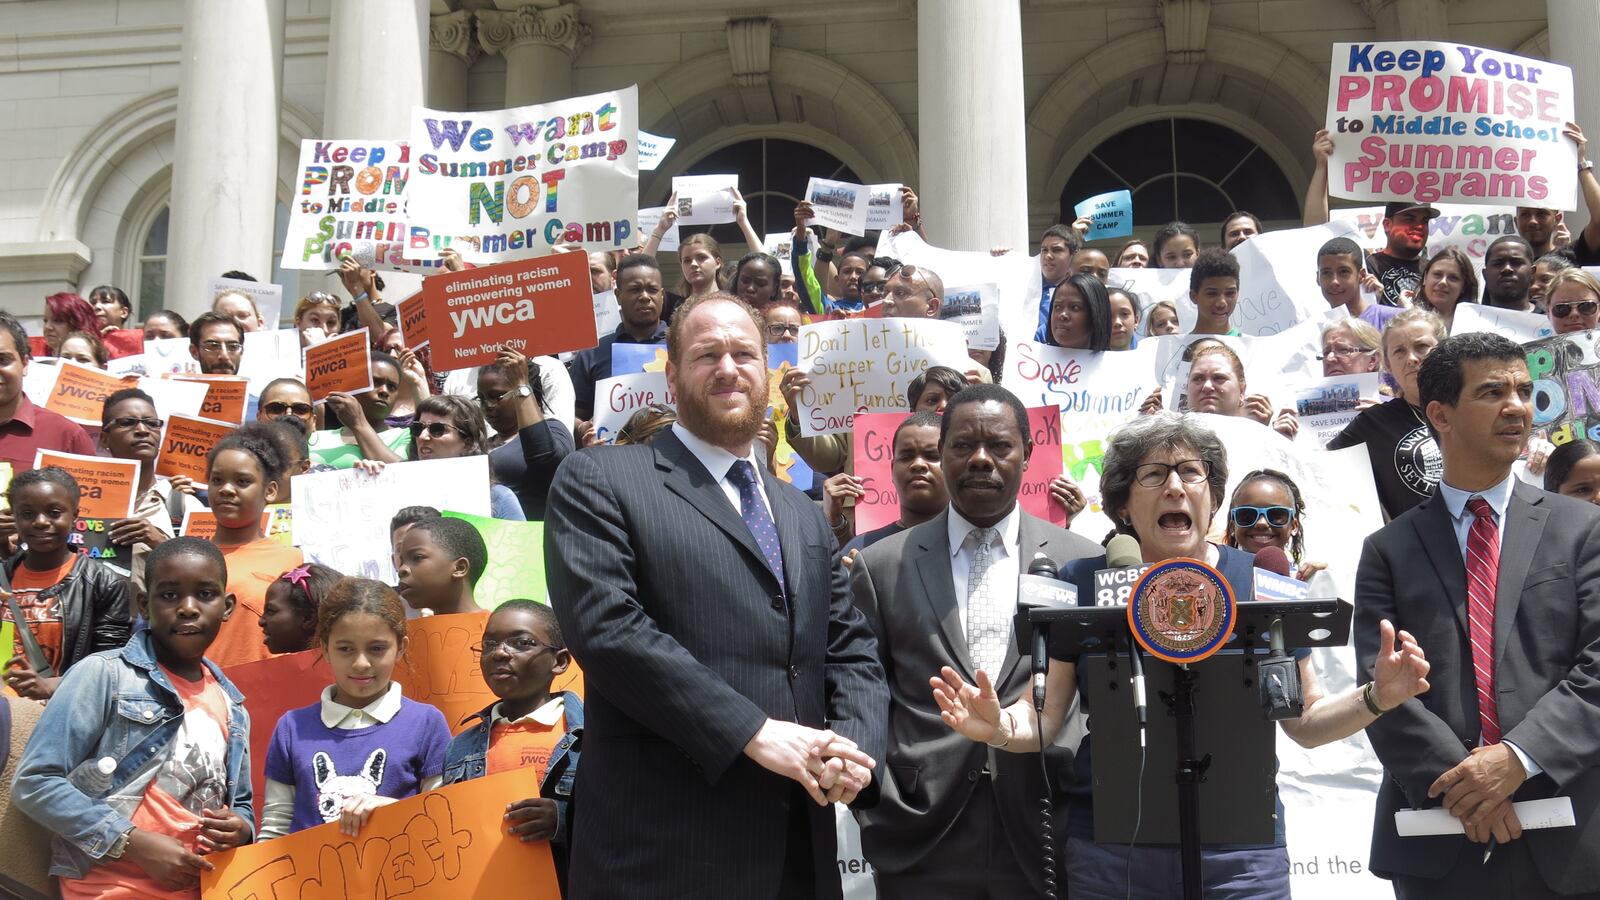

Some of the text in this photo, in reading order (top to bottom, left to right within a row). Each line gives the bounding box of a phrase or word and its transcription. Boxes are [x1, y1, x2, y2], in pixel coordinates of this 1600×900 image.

[1348, 44, 1543, 83] Keep Your
[1336, 75, 1561, 123] PROMISE
[422, 102, 618, 152] We want
[1336, 115, 1559, 143] to Middle School
[313, 141, 386, 167] Keep
[418, 138, 628, 177] Summer Camp
[1359, 136, 1537, 172] Summer
[302, 165, 409, 196] PROM
[1344, 162, 1549, 202] Programs
[301, 199, 323, 214] to
[327, 197, 398, 214] Middle
[469, 168, 566, 227] NOT
[1094, 201, 1117, 210] SAVE
[316, 215, 406, 242] Summ
[1090, 210, 1124, 220] SUMMER
[1096, 222, 1119, 230] CAMP
[1429, 213, 1516, 236] wan
[544, 218, 631, 246] Camp
[445, 265, 560, 294] eliminating racism
[447, 278, 572, 307] empowering women
[449, 299, 536, 339] ywca
[454, 338, 527, 358] New York City
[803, 323, 851, 360] Don't
[863, 322, 890, 351] let
[310, 358, 347, 381] ywca
[813, 352, 929, 388] Suffer Give
[1016, 343, 1082, 385] Save
[57, 384, 108, 402] ywca
[610, 383, 654, 413] Give
[800, 384, 837, 408] Our
[1041, 376, 1142, 413] Summer
[202, 401, 222, 413] ca
[810, 407, 854, 432] Save
[1310, 419, 1329, 427] SAVE
[1399, 428, 1429, 451] UNIV
[80, 484, 103, 499] ca
[861, 478, 899, 505] Sav
[1400, 464, 1437, 492] SETT
[76, 520, 105, 532] OVE
[520, 755, 550, 766] ywc
[1289, 855, 1362, 875] nd the
